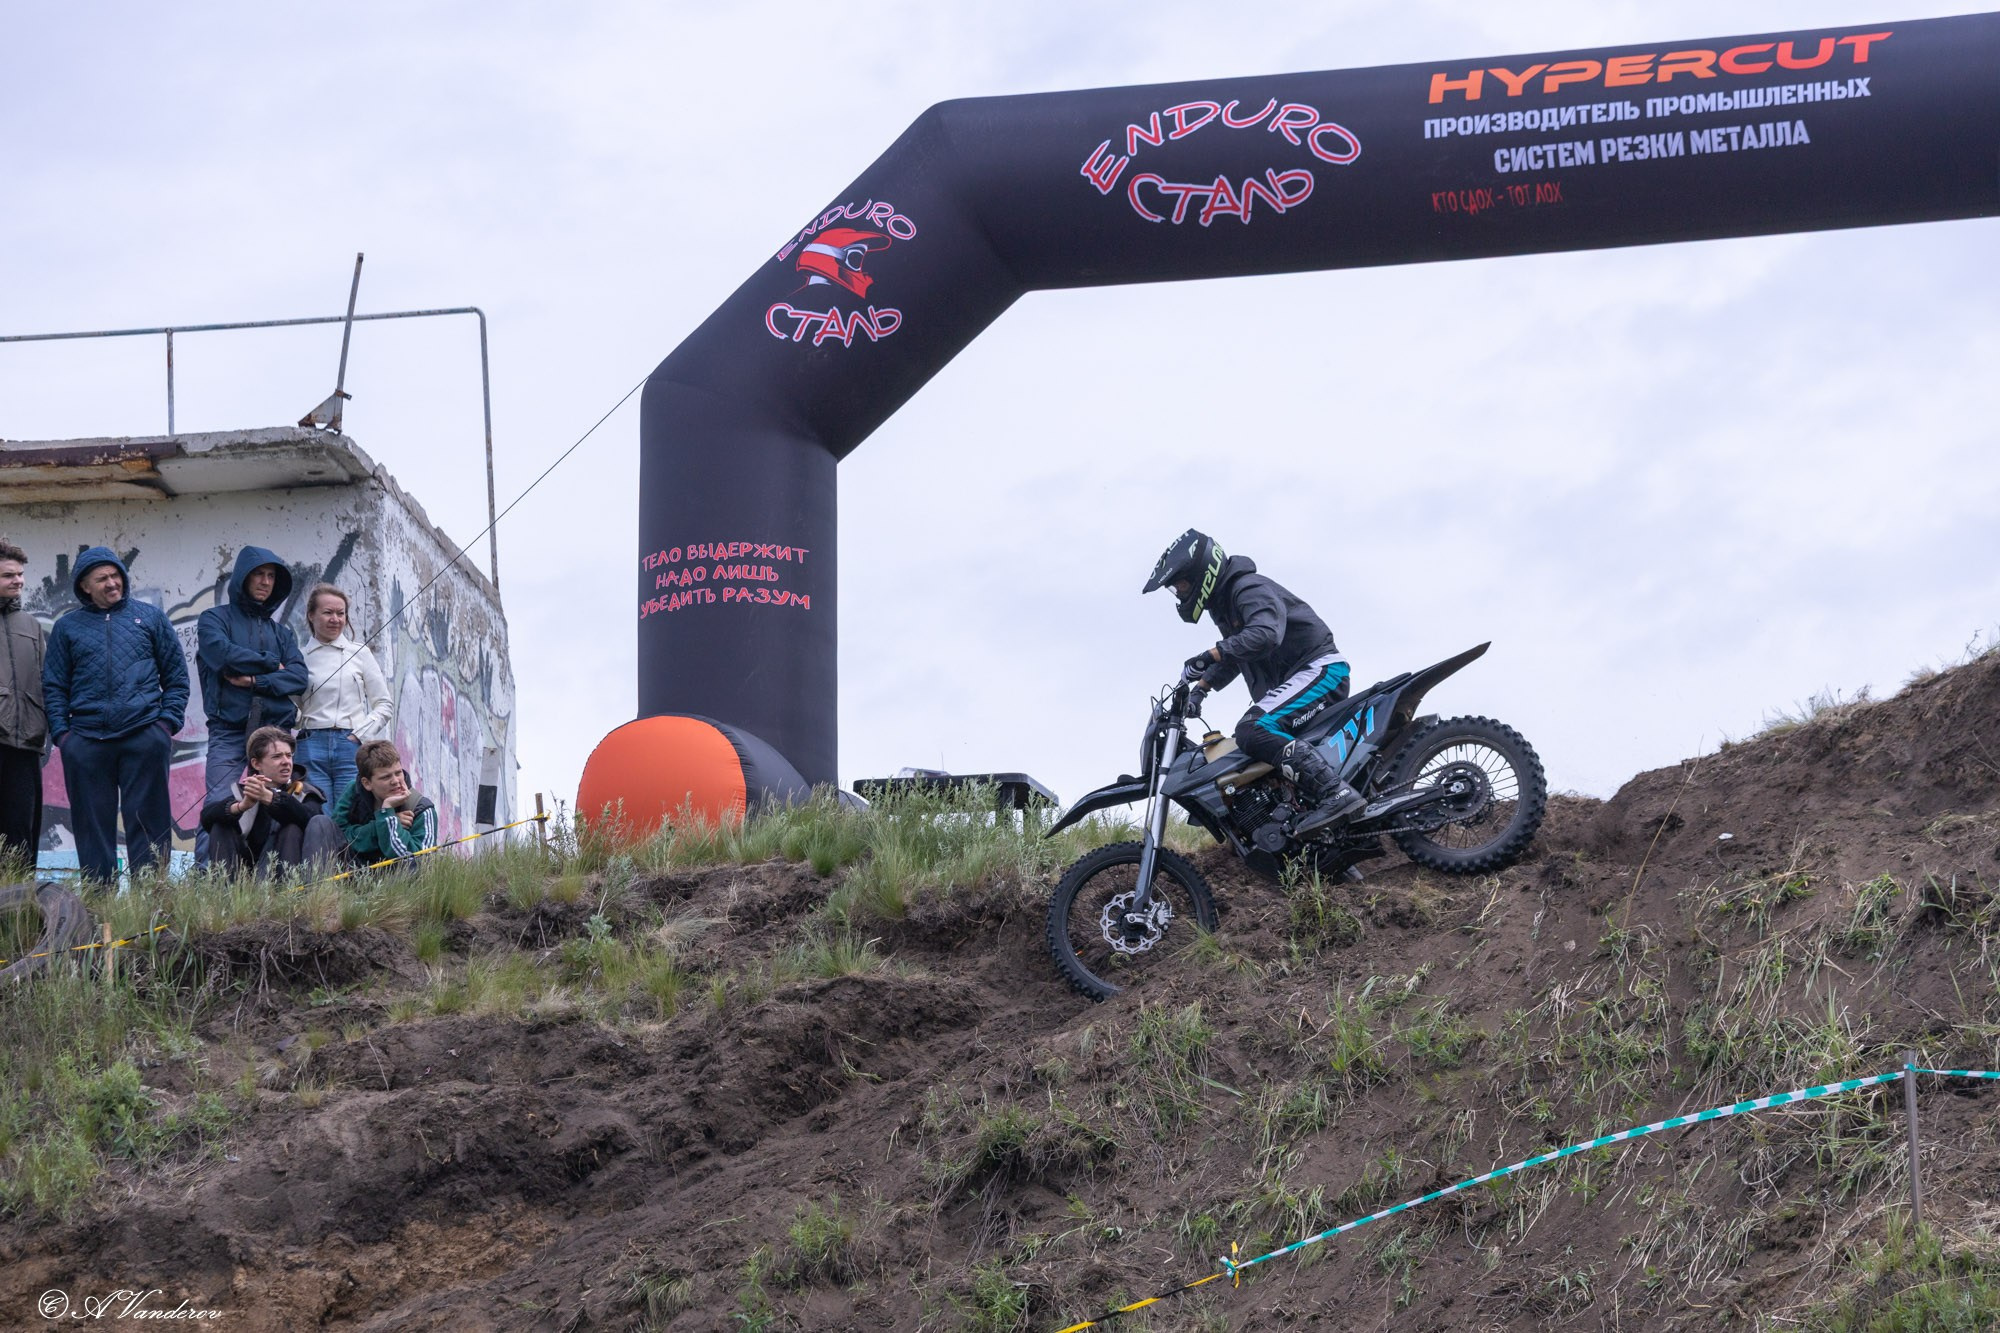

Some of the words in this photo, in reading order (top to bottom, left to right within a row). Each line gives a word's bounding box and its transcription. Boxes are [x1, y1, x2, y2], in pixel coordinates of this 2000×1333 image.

[1428, 31, 1893, 104] HYPERCUT
[1424, 100, 1640, 139] ПРОИЗВОДИТЕЛЬ
[1646, 76, 1872, 119] ПРОМЫШЛЕННЫХ
[1081, 98, 1361, 195] ENDURO
[1494, 139, 1596, 173] СИСТЕМ
[1601, 131, 1685, 164] РЕЗКИ
[1691, 119, 1811, 155] МЕТАЛЛА
[1431, 191, 1458, 213] КТО
[1506, 183, 1531, 207] ТОТ
[1535, 181, 1564, 206] ЛОХ
[776, 198, 917, 262] ENDURO
[642, 547, 682, 572] ТЕЛО
[687, 542, 810, 564] ВЫДЕРЖИТ
[655, 565, 707, 590] НАДО
[712, 564, 779, 582] ЛИШЬ
[640, 588, 716, 620] УБЕДИТЬ
[722, 586, 811, 610] РАЗУМ
